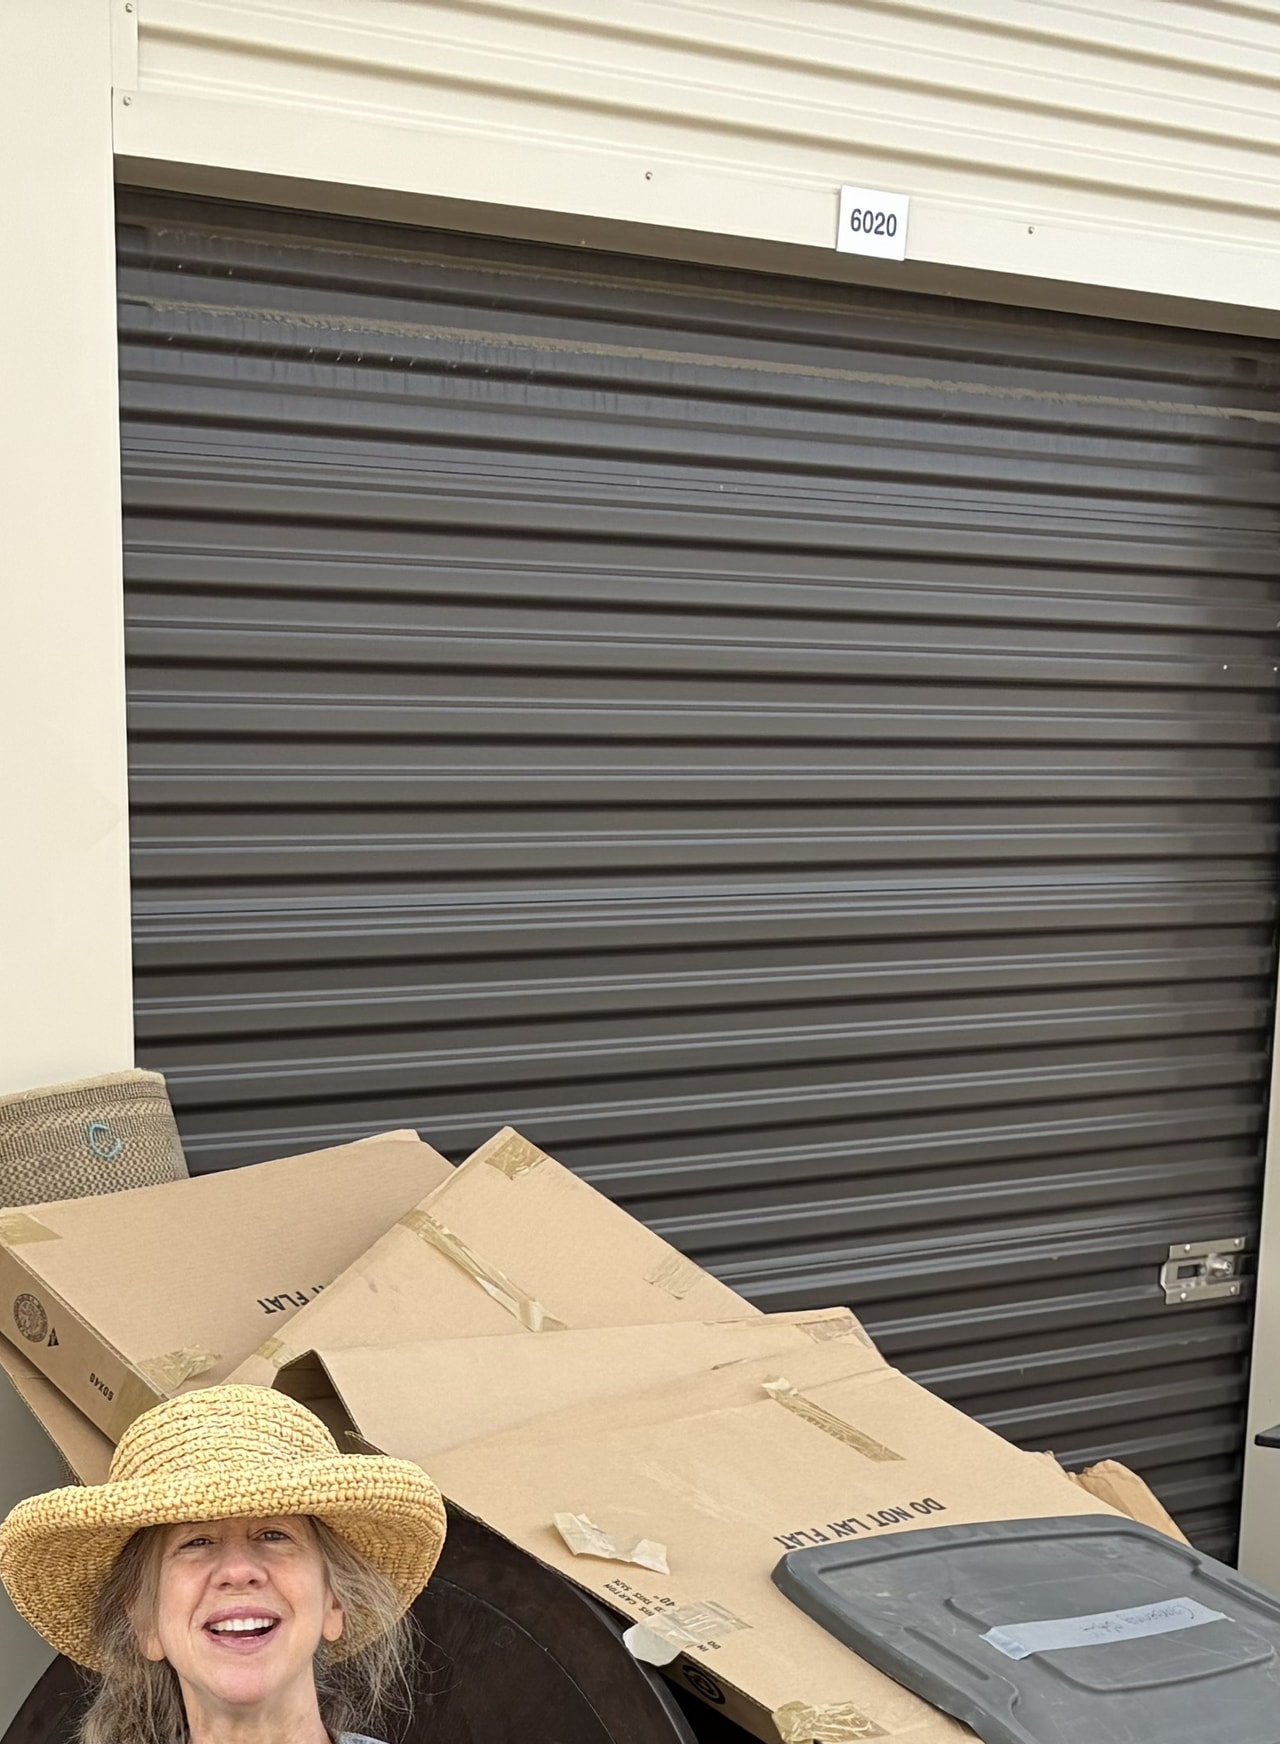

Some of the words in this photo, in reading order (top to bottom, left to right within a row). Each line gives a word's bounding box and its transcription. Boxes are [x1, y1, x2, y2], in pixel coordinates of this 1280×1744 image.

[850, 207, 898, 237] 6020
[256, 1290, 311, 1315] FLAT
[867, 1506, 916, 1528] NOT
[909, 1497, 948, 1516] DO
[772, 1528, 832, 1550] FLAT
[826, 1518, 873, 1539] LAY
